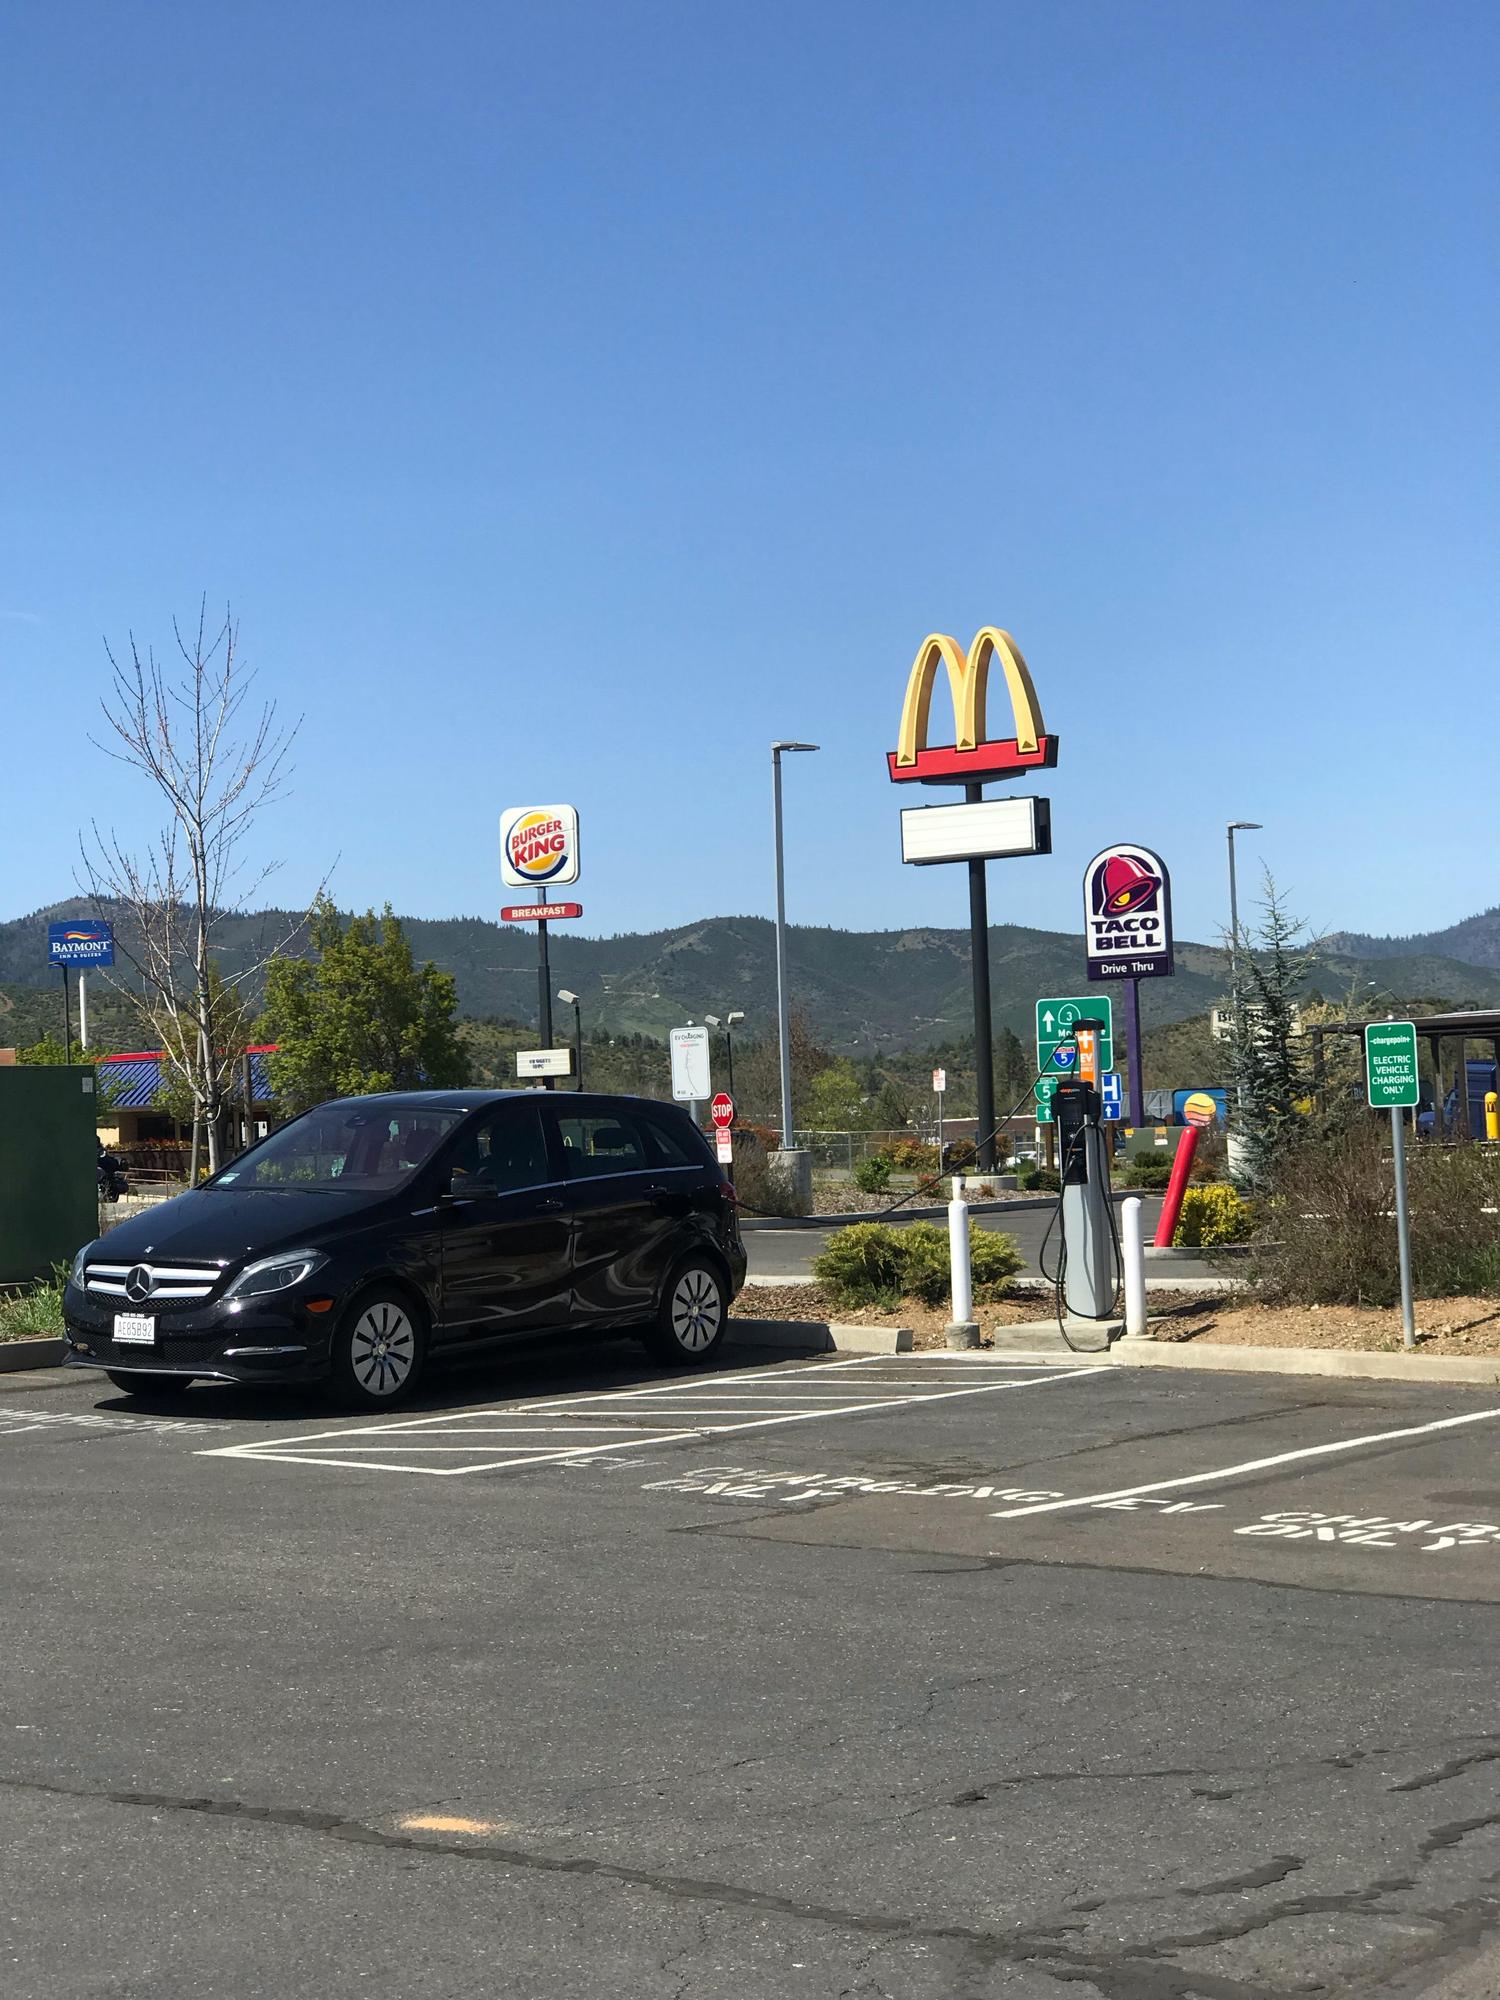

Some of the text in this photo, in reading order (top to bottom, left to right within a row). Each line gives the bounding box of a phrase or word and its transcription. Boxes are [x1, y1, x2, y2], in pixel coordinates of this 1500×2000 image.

[512, 820, 562, 849] BURGER
[514, 834, 564, 867] KING
[511, 906, 566, 918] BREAKFAST
[1091, 917, 1159, 934] TACO
[52, 941, 110, 953] BAYMONT
[1096, 934, 1161, 950] BELL
[1101, 962, 1154, 974] Drive Thru
[1066, 1011, 1073, 1021] 3
[1061, 1053, 1068, 1064] 5
[1080, 1053, 1093, 1062] EV
[1373, 1055, 1411, 1064] ELECTRIC
[1376, 1065, 1410, 1074] VEHICLE
[1371, 1075, 1415, 1085] CHARGING
[1043, 1086, 1050, 1098] 5
[1383, 1085, 1404, 1094] ONLY
[713, 1104, 731, 1117] STOP
[640, 1479, 843, 1501] ONLY
[683, 1466, 1064, 1502] CHARGING
[1091, 1498, 1226, 1513] EV
[1233, 1523, 1490, 1550] ONLY
